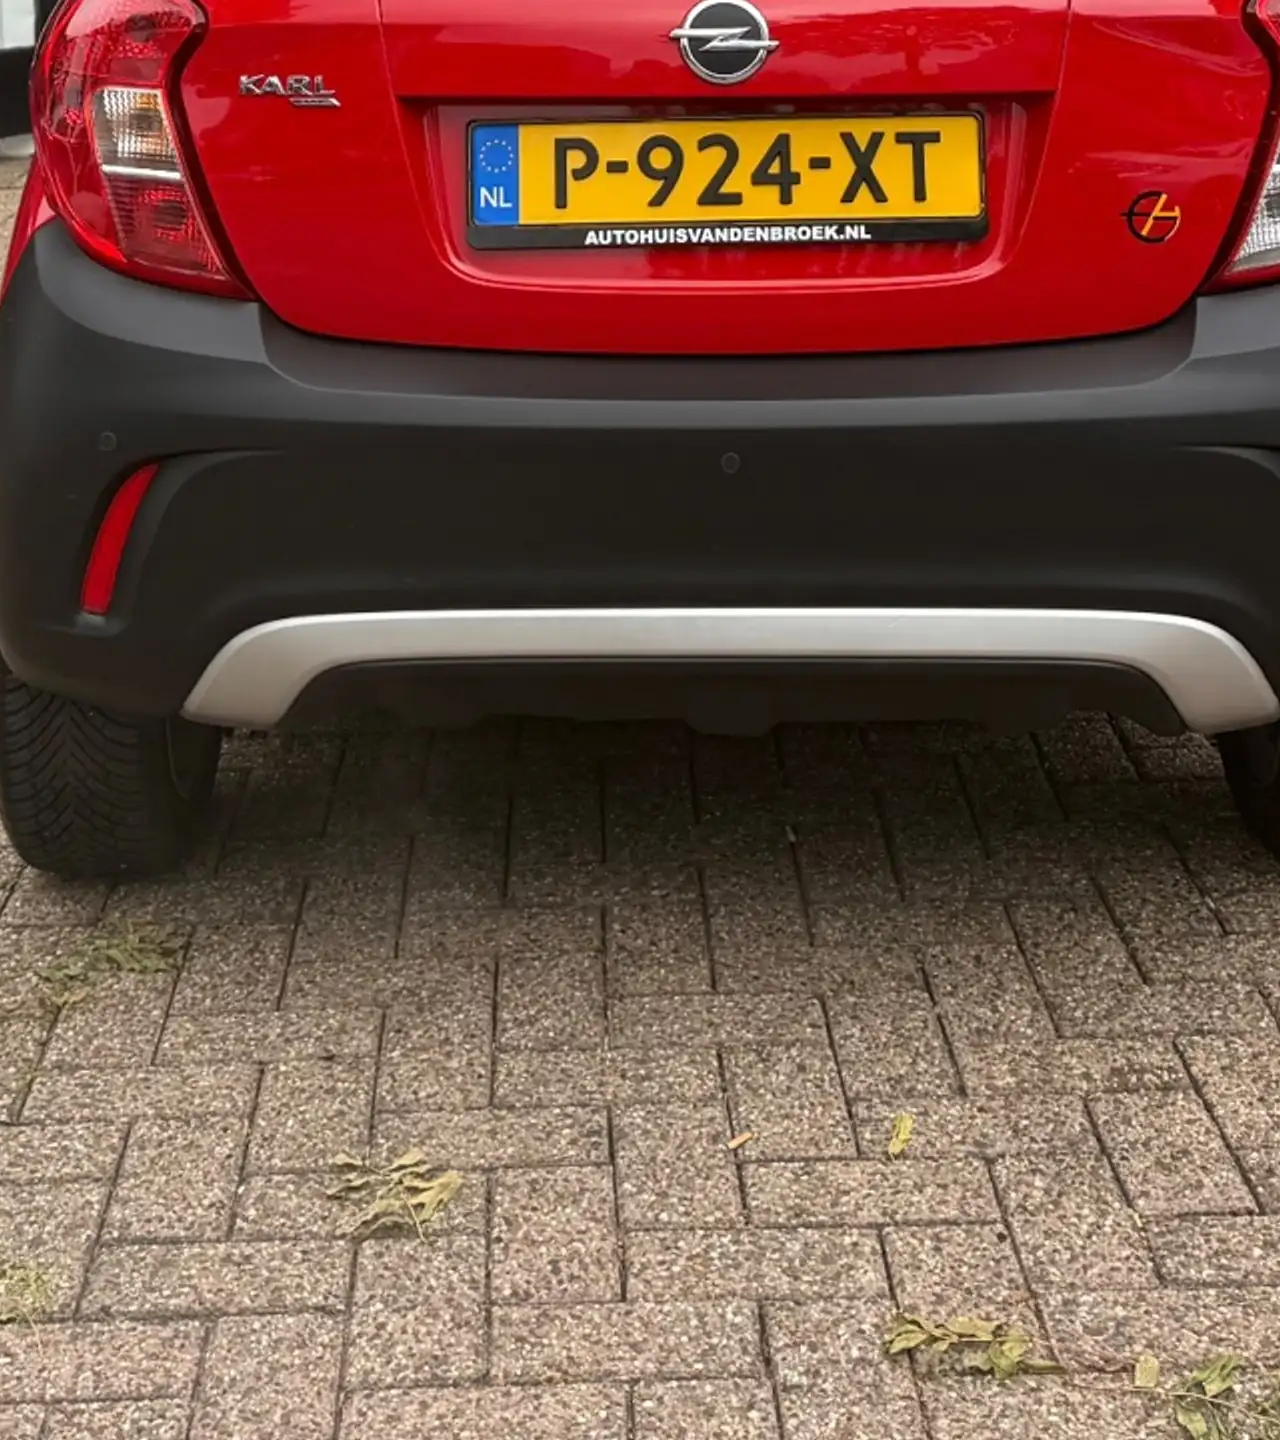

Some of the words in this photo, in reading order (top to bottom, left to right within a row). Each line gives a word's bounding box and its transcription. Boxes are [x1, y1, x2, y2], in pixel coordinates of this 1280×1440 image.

[239, 74, 336, 95] KARL
[554, 131, 941, 210] P-924-XT
[479, 186, 513, 209] NL
[584, 224, 872, 246] AUTOHUISVANDENBROEK.NL
